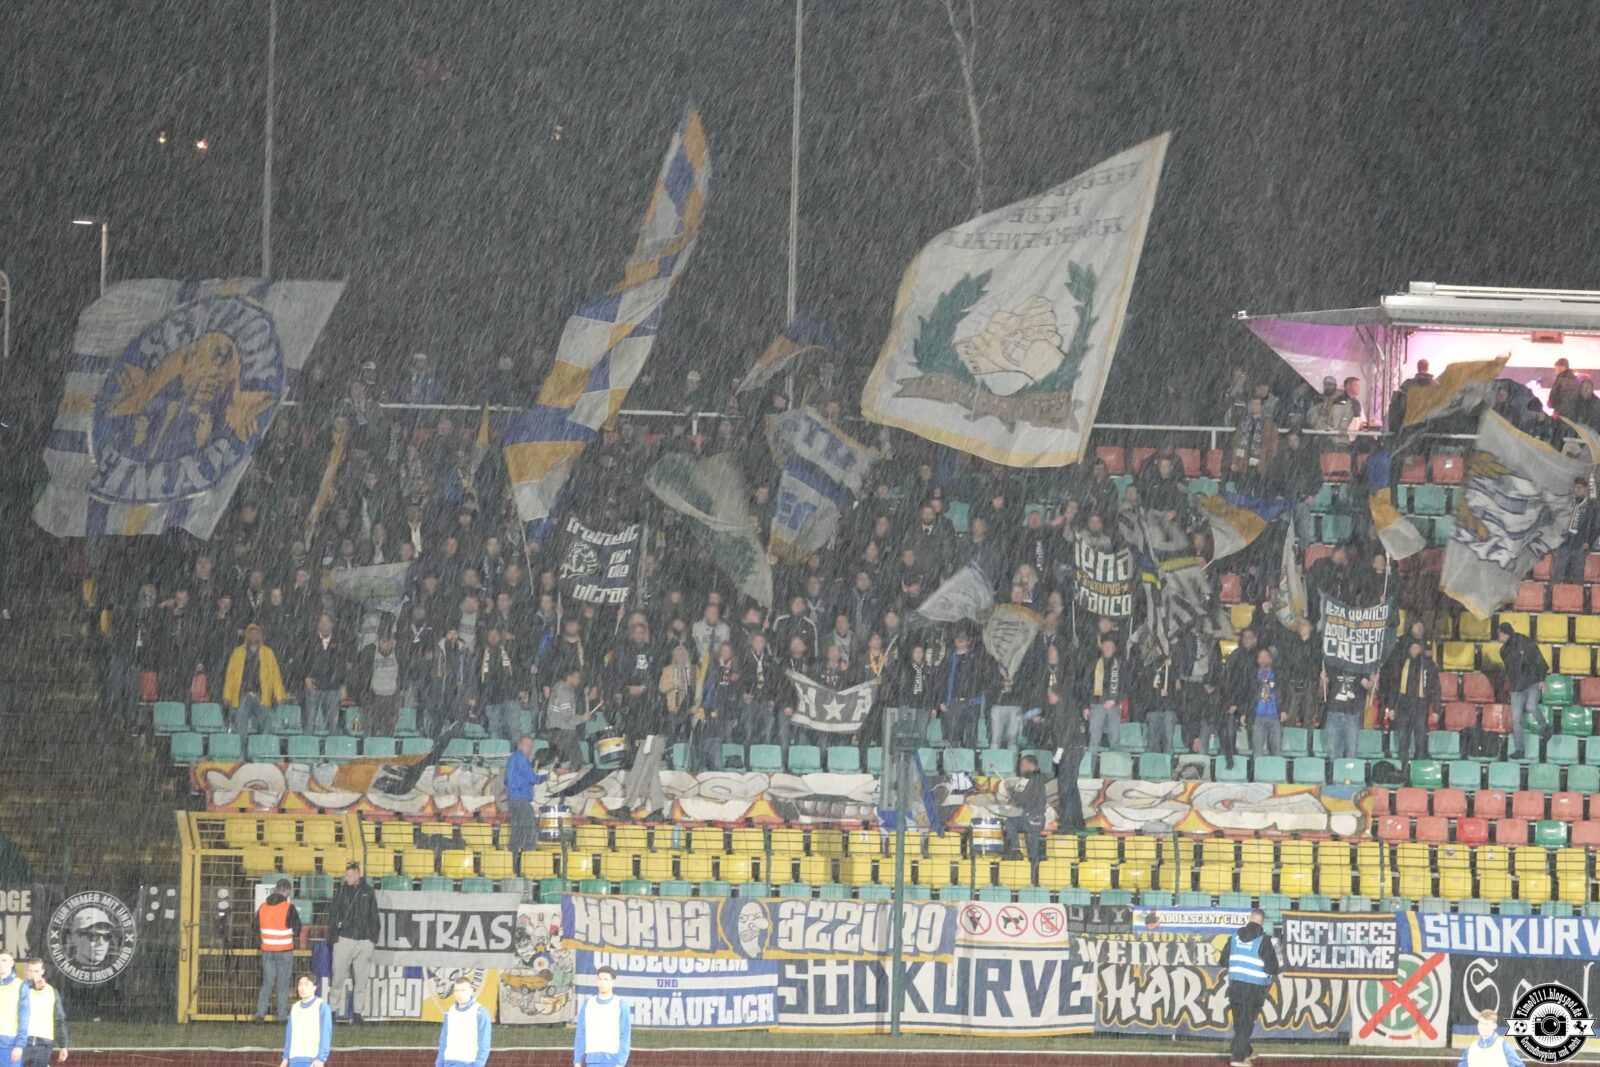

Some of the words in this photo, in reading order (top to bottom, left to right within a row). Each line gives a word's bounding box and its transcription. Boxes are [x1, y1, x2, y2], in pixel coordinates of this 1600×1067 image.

[88, 438, 241, 498] EIMAR
[68, 893, 100, 909] IMMER
[101, 895, 119, 909] MIT
[1159, 913, 1221, 925] ADOLESCENT
[1287, 920, 1397, 945] REFUGEES
[1077, 938, 1219, 966] WEIMAR
[1286, 944, 1395, 968] WELCOME
[60, 960, 90, 980] IMMER
[656, 978, 679, 989] UND
[777, 956, 1095, 1018] SÜDKURVE
[576, 991, 775, 1027] RKÄUFLICH
